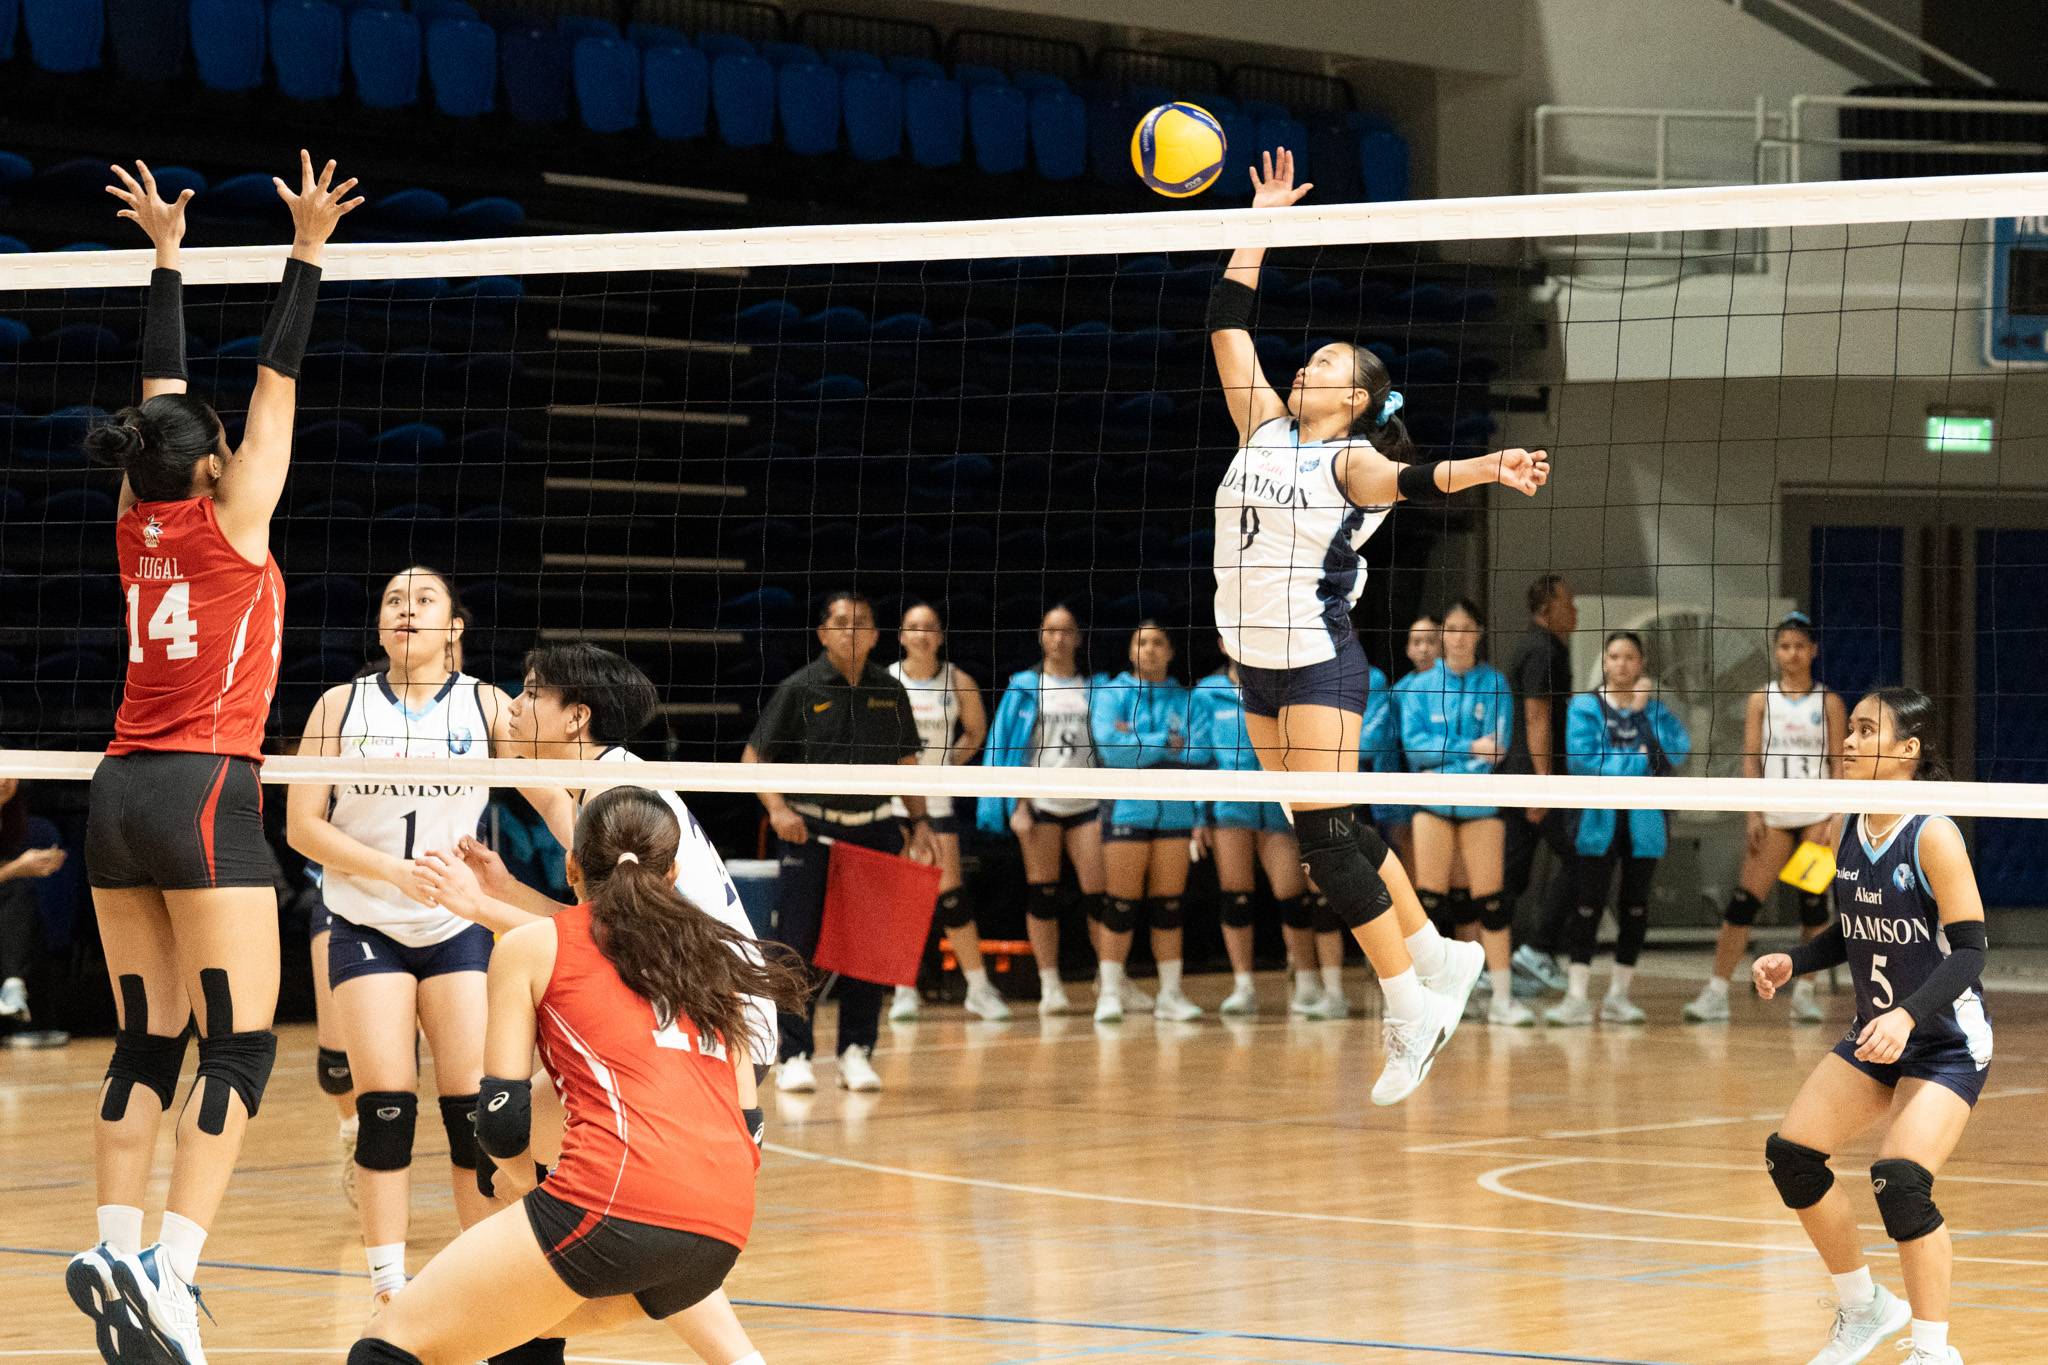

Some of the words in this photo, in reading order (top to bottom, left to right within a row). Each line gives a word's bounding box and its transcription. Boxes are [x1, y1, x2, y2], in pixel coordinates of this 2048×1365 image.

[135, 556, 184, 580] JUGAL
[126, 581, 198, 663] 14
[400, 810, 417, 860] 1
[1854, 886, 1883, 905] Akari
[358, 941, 377, 961] 1
[1870, 953, 1894, 1009] 5
